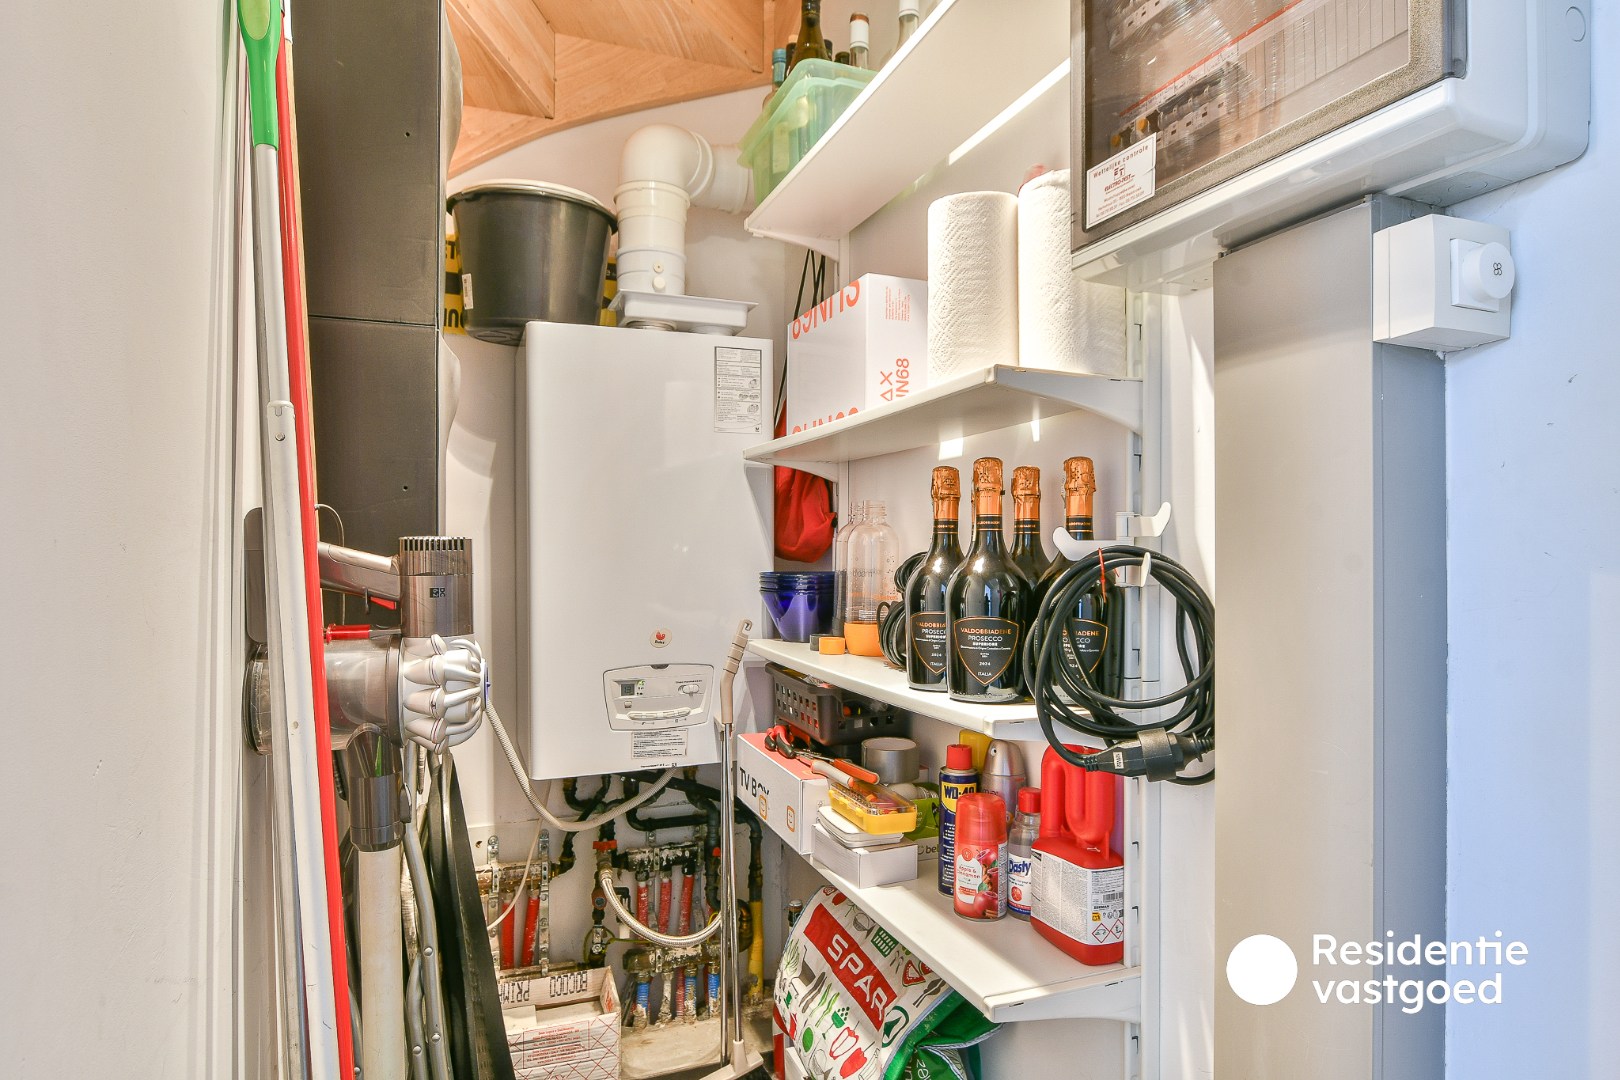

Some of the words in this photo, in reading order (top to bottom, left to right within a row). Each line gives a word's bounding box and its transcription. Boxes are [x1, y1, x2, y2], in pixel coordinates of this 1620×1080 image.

[960, 627, 1012, 635] VALDOBBIADENE
[740, 766, 750, 791] TV
[943, 785, 975, 799] WD-40
[1008, 859, 1031, 876] Dasty
[827, 934, 888, 1021] SPAR
